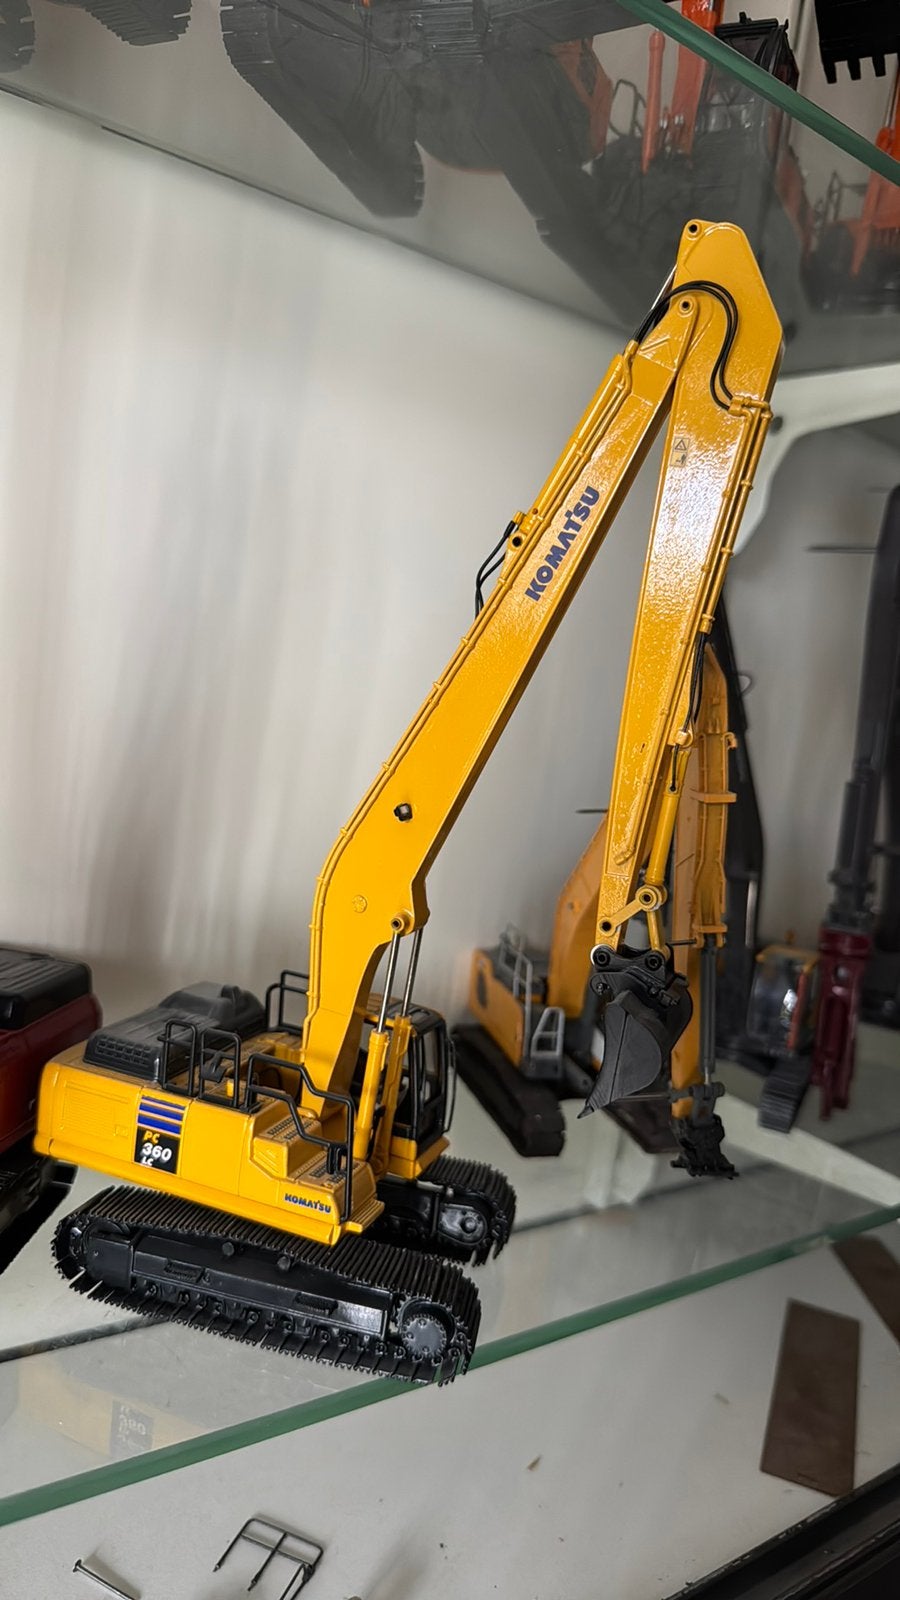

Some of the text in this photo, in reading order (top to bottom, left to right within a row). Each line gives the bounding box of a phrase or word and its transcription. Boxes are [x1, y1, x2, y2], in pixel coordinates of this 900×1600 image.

[525, 486, 600, 601] KOMATSU
[143, 1130, 161, 1143] PC
[141, 1142, 172, 1162] 360
[141, 1156, 154, 1167] LC
[284, 1193, 331, 1213] KOMATSU
